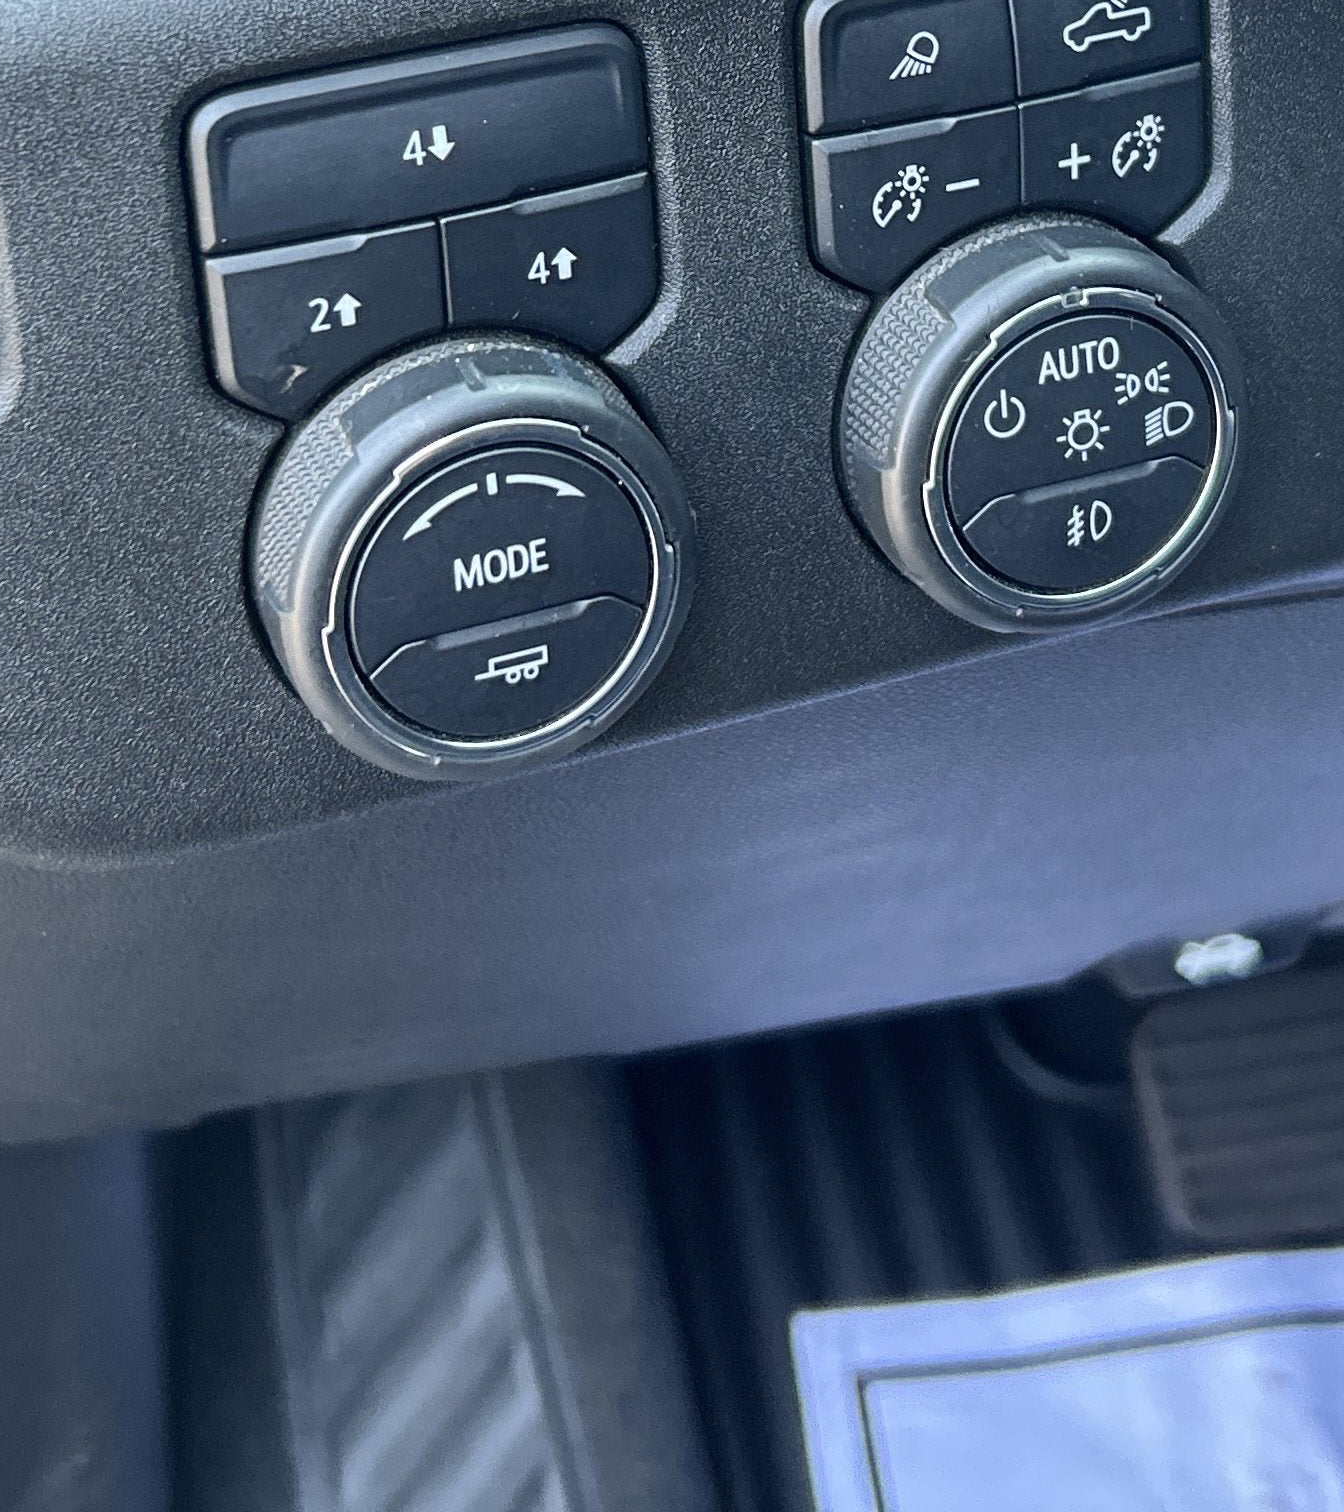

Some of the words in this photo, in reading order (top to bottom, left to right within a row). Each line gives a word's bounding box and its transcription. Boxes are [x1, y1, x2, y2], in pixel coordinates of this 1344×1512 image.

[402, 130, 427, 167] 4
[527, 251, 551, 285] 4
[308, 297, 332, 333] 2
[1037, 336, 1120, 385] AUTO
[453, 538, 550, 592] MODE
